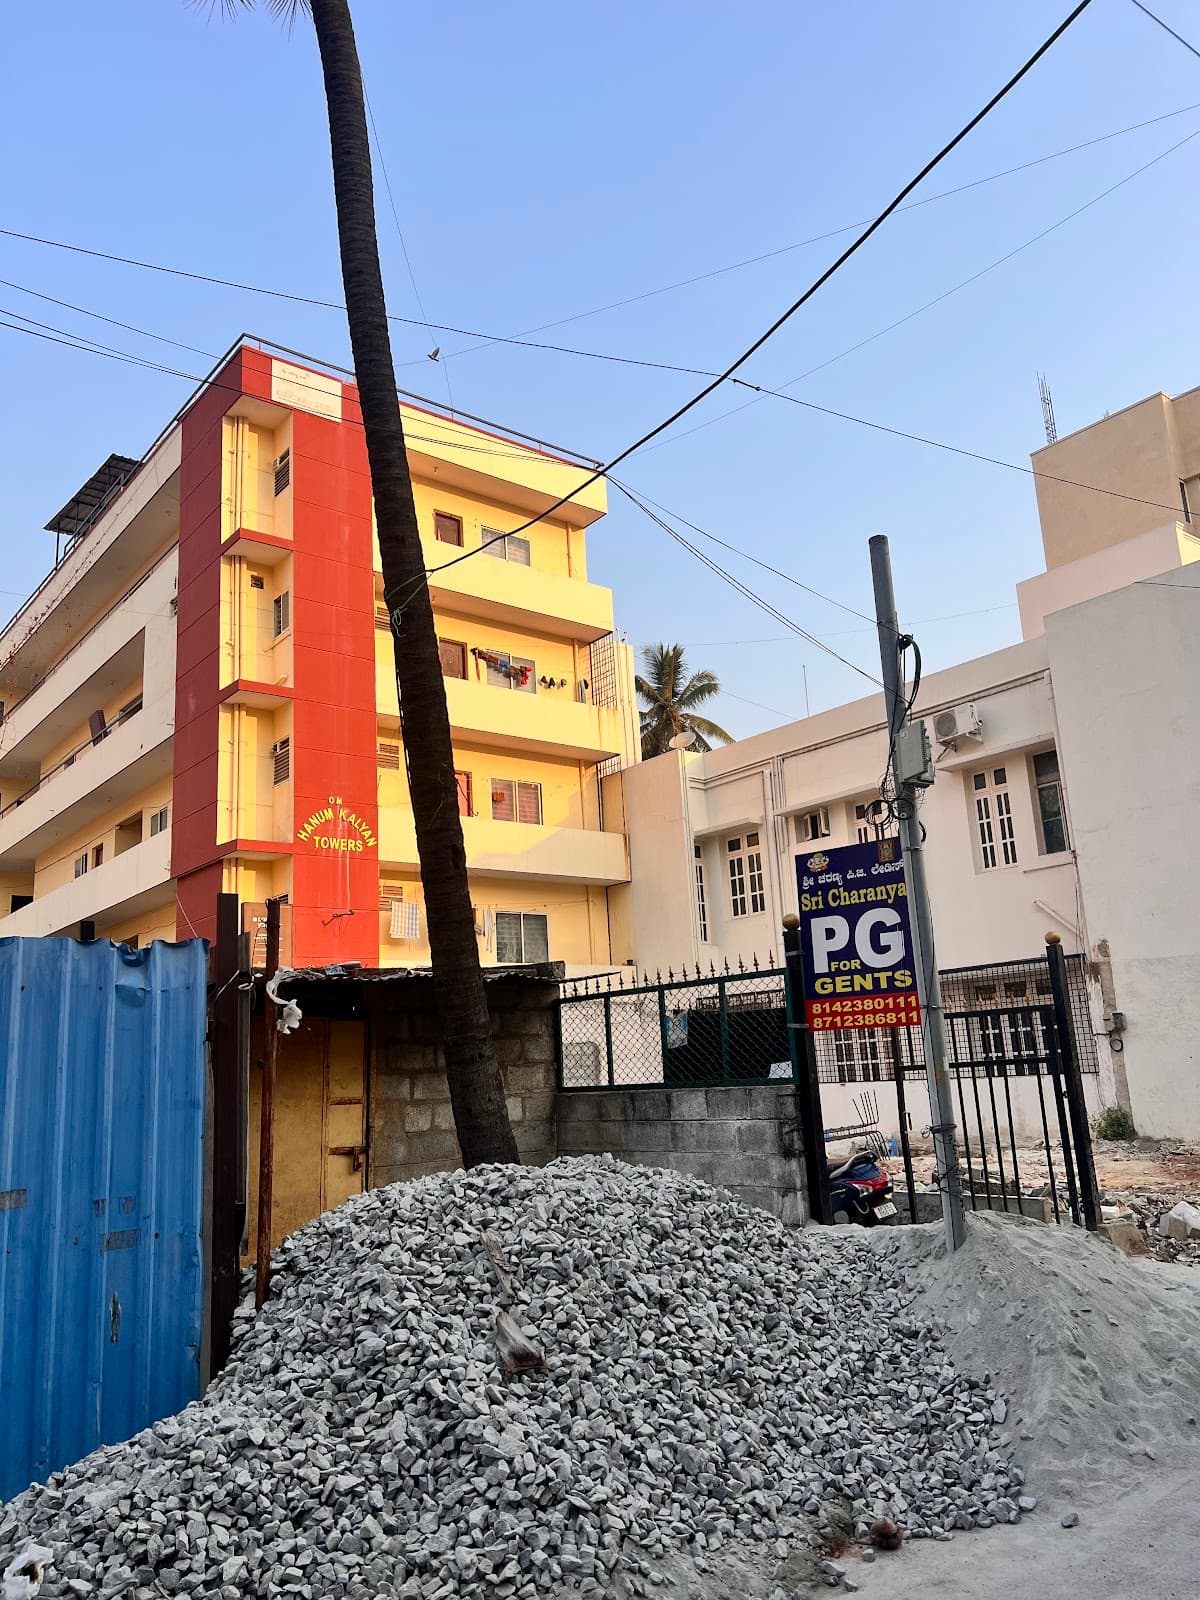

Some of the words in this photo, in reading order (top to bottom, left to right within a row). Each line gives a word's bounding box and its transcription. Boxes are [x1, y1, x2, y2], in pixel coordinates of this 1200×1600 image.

[328, 796, 342, 805] OM
[297, 808, 334, 841] HANUM
[339, 808, 377, 847] KALYAN
[313, 836, 363, 852] TOWERS
[801, 891, 824, 911] Sri
[828, 882, 907, 907] Charanya
[810, 907, 905, 974] PG
[830, 959, 861, 972] FOR
[814, 969, 913, 994] GENTS
[812, 995, 917, 1014] 8142380111
[813, 1011, 918, 1028] 8712386811
